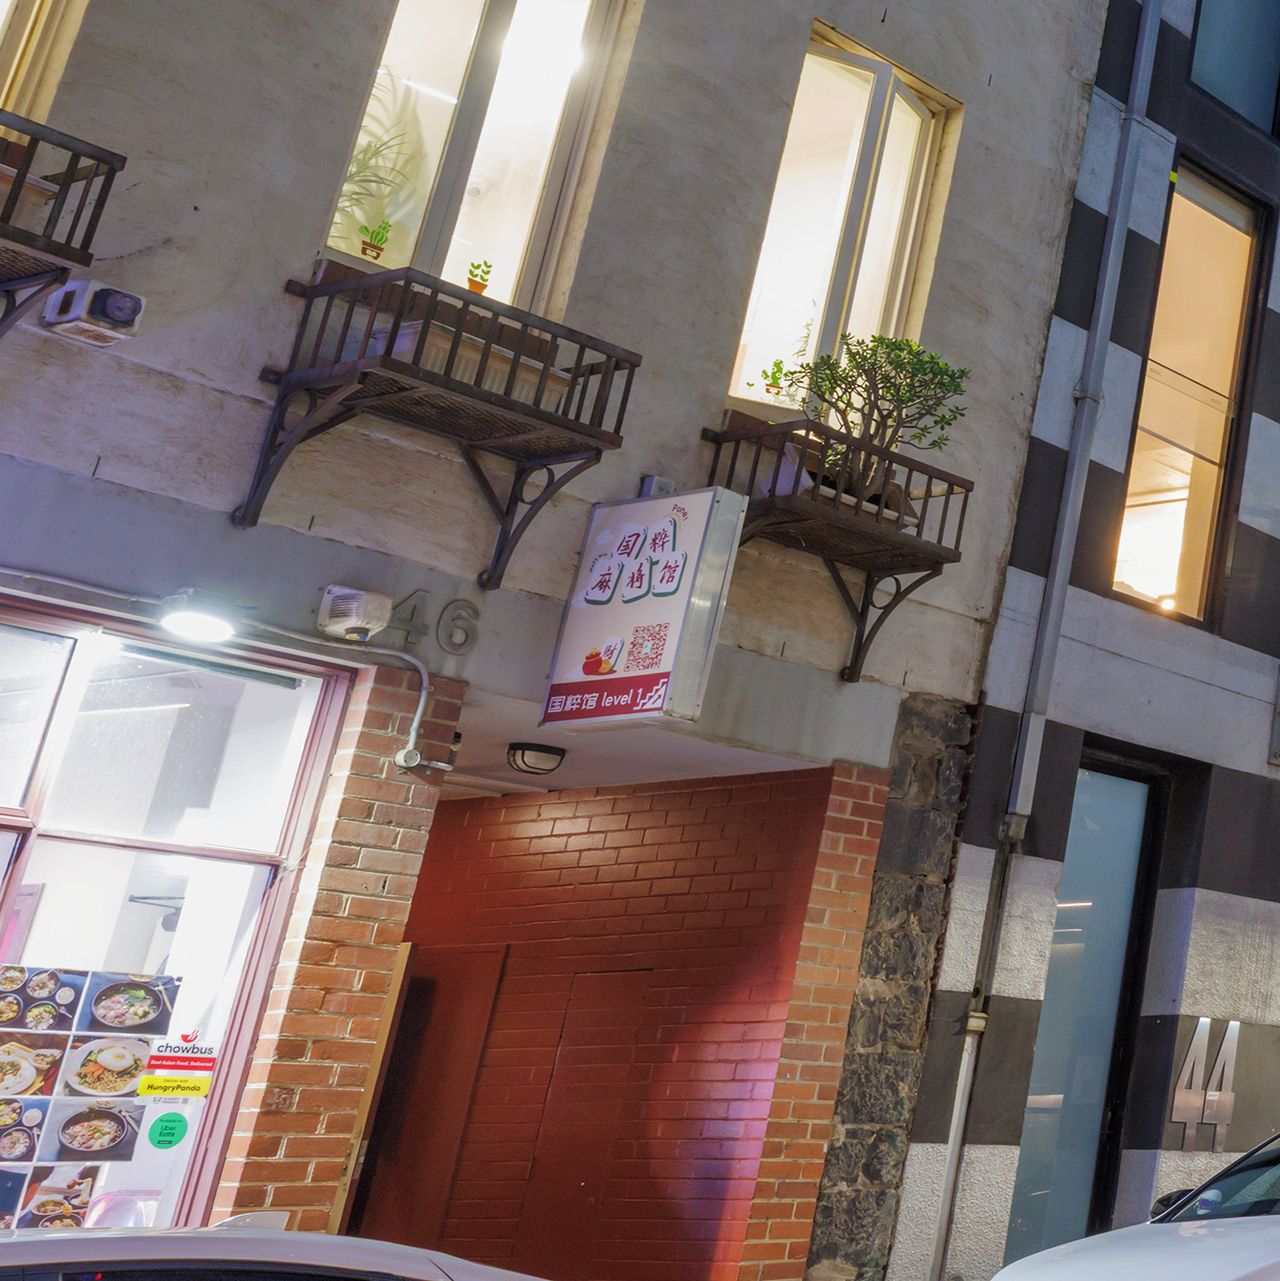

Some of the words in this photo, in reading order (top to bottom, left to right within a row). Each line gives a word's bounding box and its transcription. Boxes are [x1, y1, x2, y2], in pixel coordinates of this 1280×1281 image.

[616, 528, 670, 558] 国粹
[591, 559, 680, 594] 麻将馆
[547, 692, 599, 713] 国粹馆
[601, 689, 634, 707] level
[636, 688, 643, 704] 1
[157, 1042, 214, 1056] chowbus
[147, 1083, 201, 1093] HungryPanda
[1171, 1016, 1241, 1153] 44
